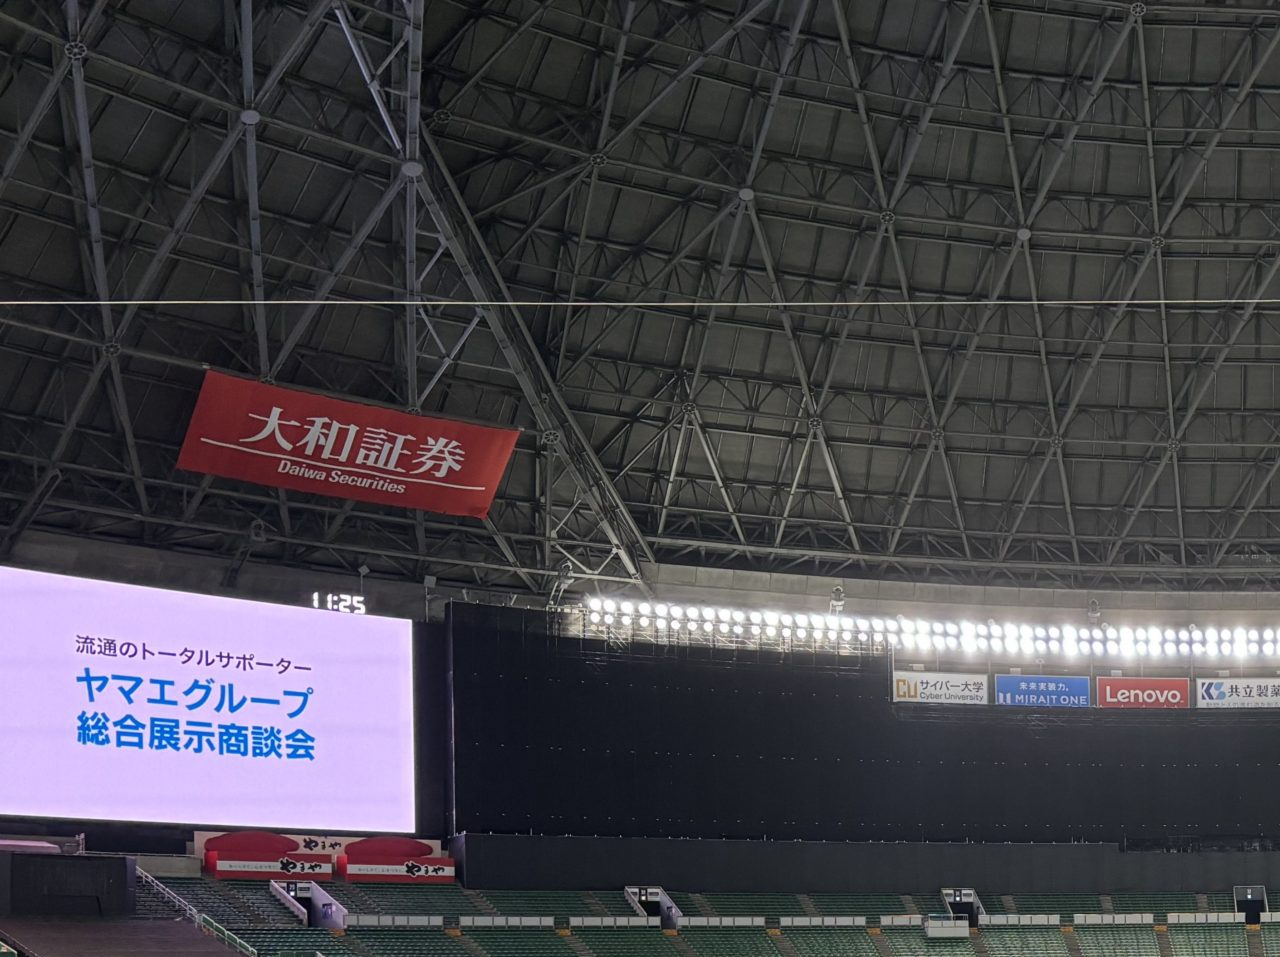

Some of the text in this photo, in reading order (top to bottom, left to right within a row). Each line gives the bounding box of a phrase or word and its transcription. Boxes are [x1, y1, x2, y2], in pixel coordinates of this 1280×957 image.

[239, 406, 466, 479] 大和証券
[277, 459, 406, 494] Daiwa Securities
[312, 592, 366, 615] 11:25
[75, 635, 312, 676] 流通のトータルサポーター
[76, 667, 313, 719] ヤマエグループ
[919, 691, 984, 702] Cyber University
[920, 679, 984, 693] サイバー大学
[1015, 694, 1087, 705] MIRAIT ONE
[1106, 685, 1181, 703] Lenovo
[77, 710, 315, 760] 総合展示商談会
